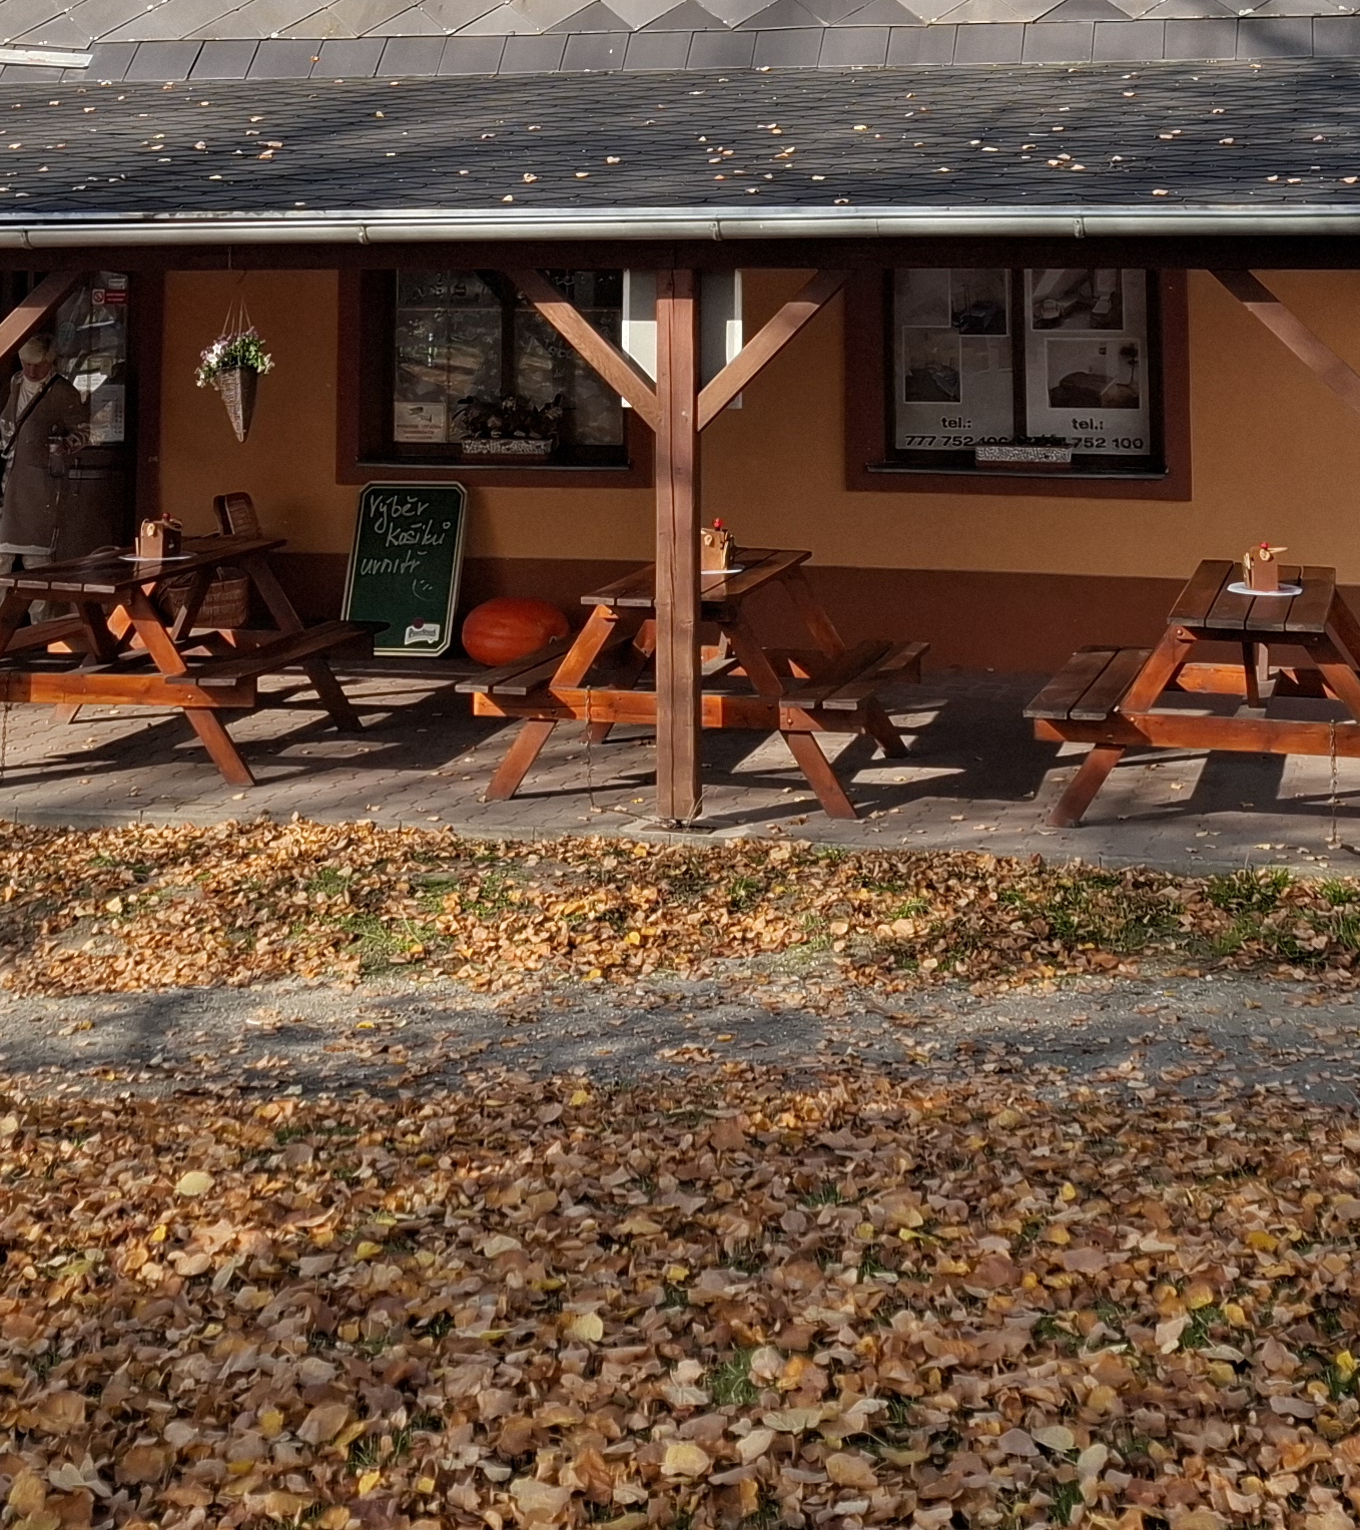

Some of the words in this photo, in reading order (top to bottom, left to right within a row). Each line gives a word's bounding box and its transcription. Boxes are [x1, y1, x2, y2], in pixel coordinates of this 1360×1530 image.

[941, 416, 972, 429] tel.:
[1071, 417, 1104, 430] tel.:
[904, 435, 937, 446] 777
[940, 435, 974, 447] 752
[1071, 436, 1107, 448] 752
[1111, 437, 1144, 449] 100
[370, 494, 430, 534] Výběr
